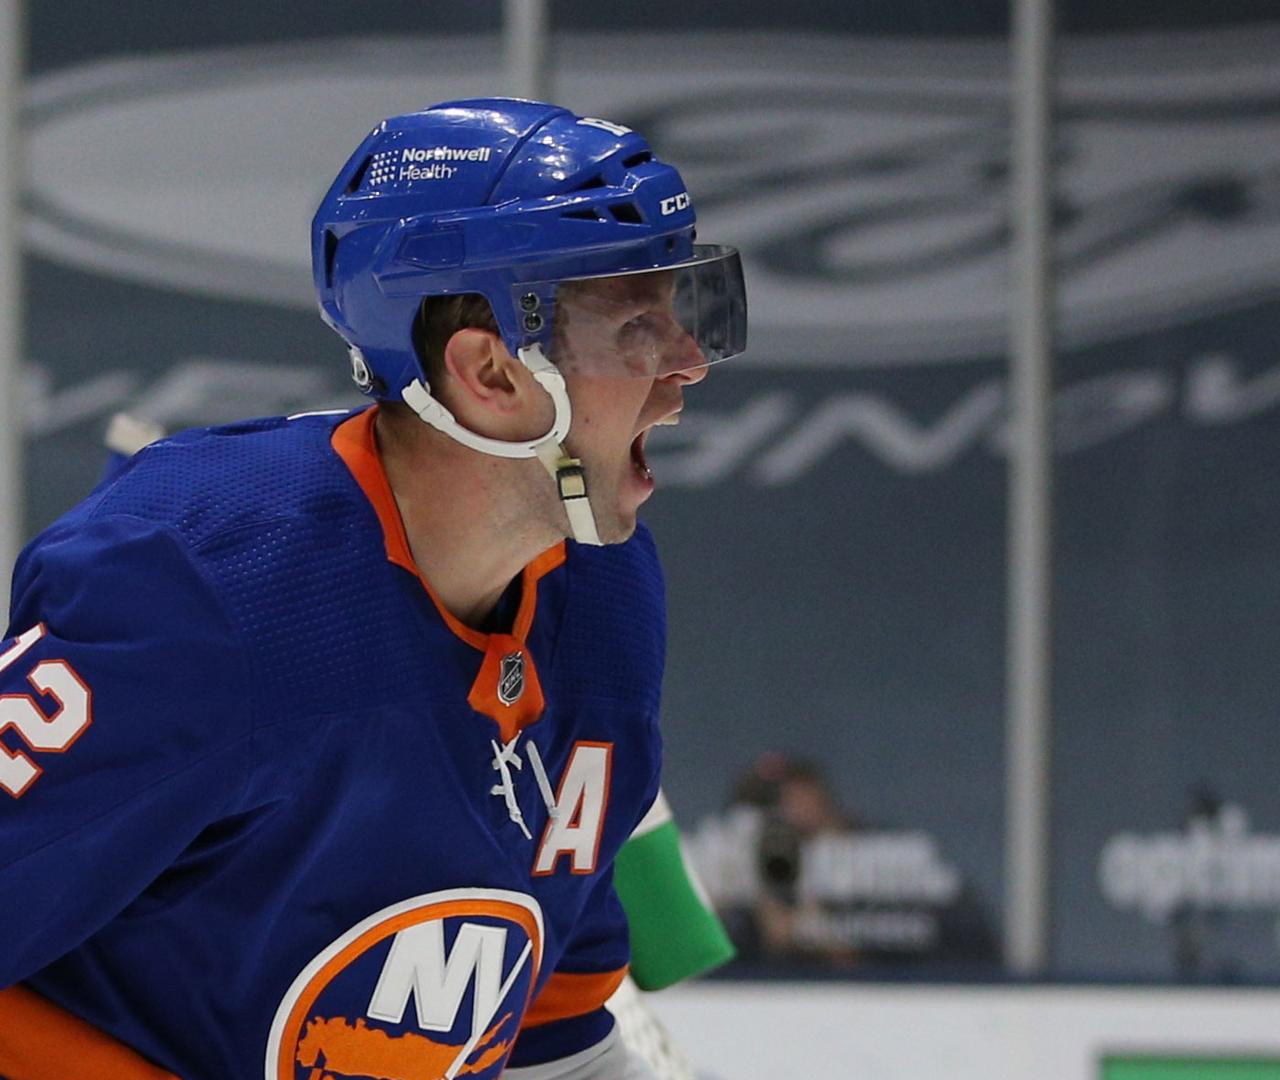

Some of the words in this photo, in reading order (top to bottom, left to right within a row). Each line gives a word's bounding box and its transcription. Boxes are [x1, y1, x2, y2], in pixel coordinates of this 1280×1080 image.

[399, 164, 452, 181] Health
[401, 146, 491, 163] Northwell
[531, 741, 614, 876] A
[366, 918, 509, 1035] NY
